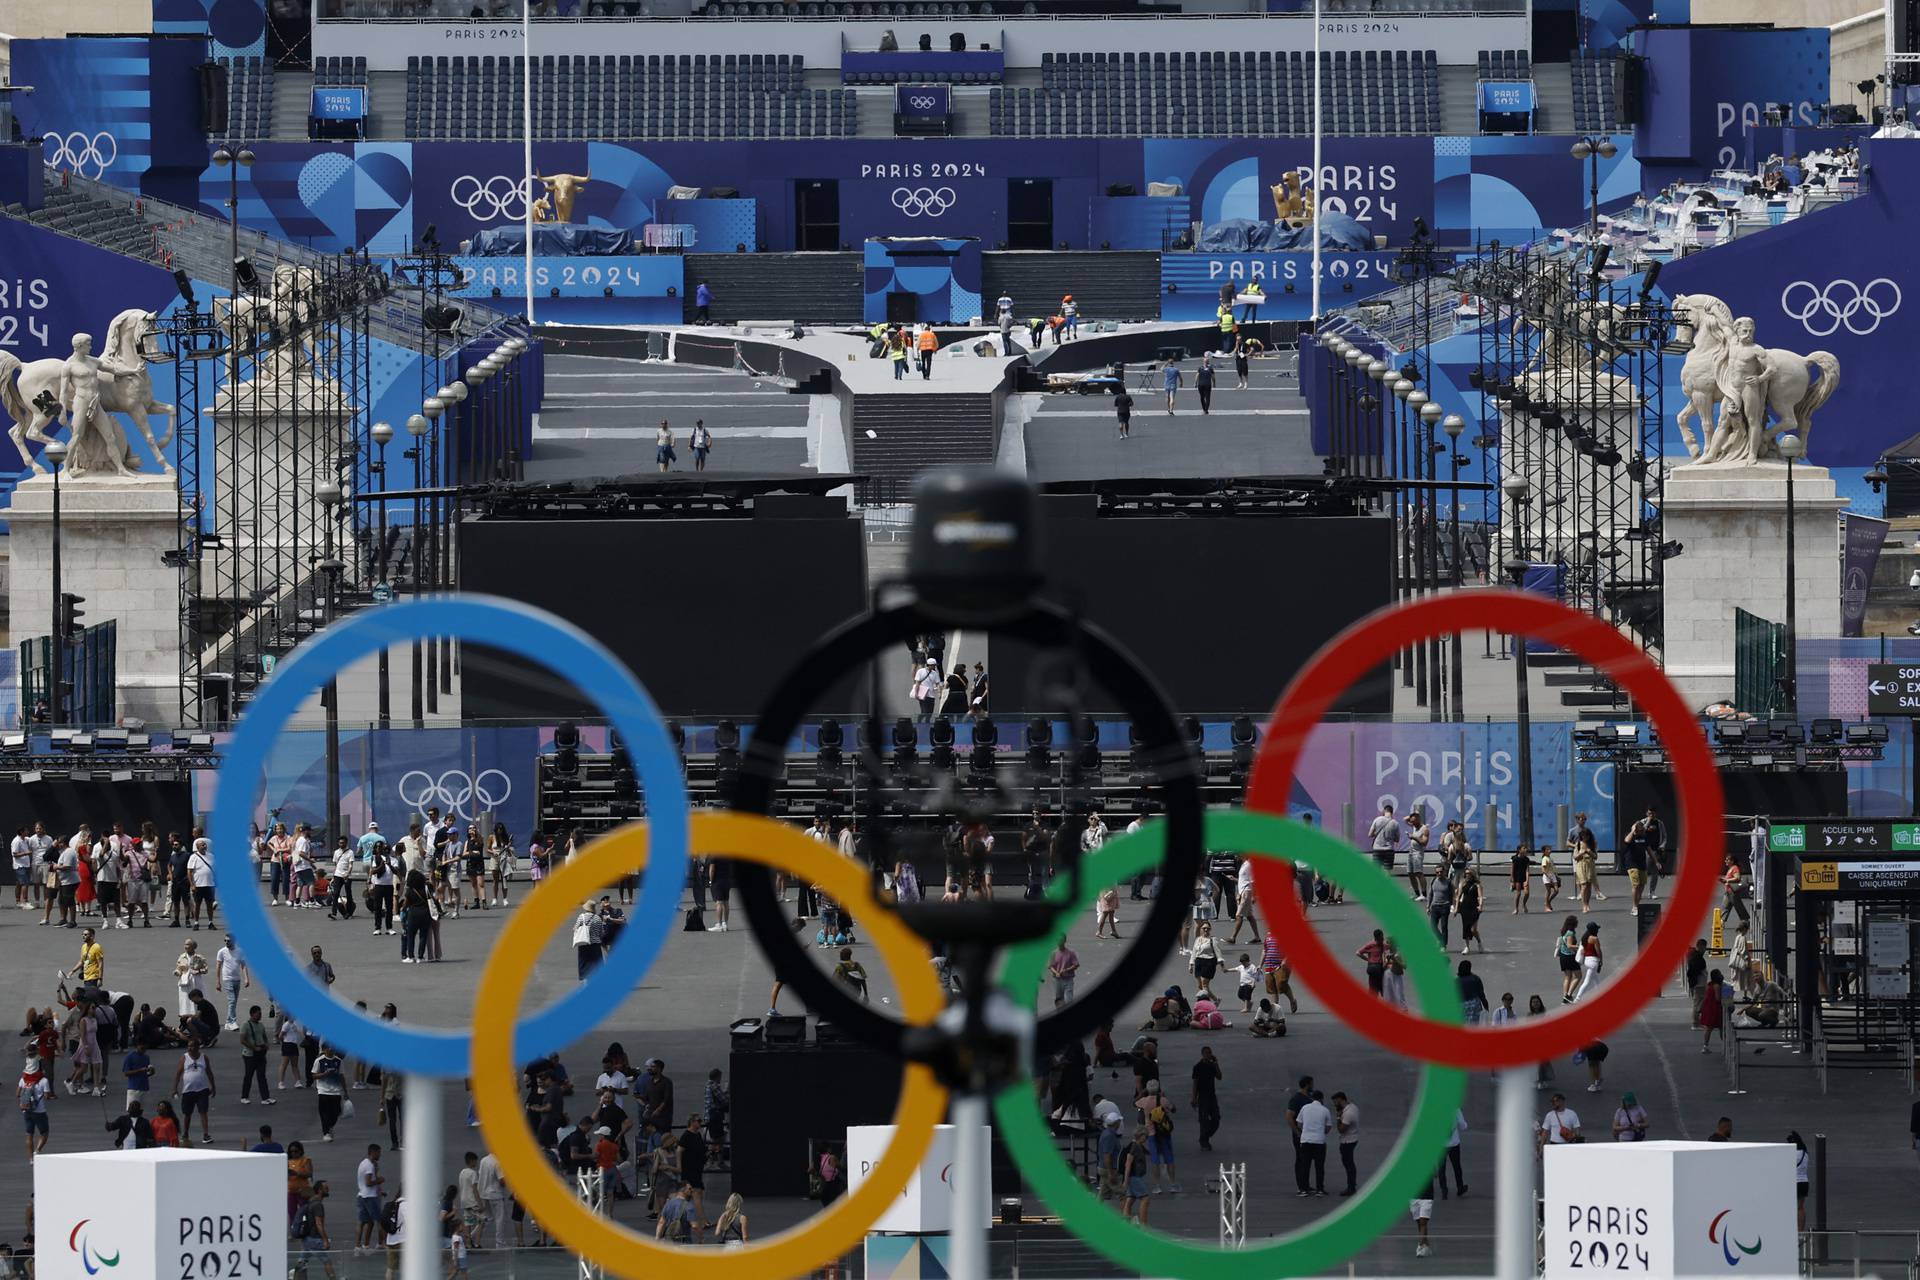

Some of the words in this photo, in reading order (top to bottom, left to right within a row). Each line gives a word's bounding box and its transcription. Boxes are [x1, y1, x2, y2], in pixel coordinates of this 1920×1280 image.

[1363, 23, 1399, 33] 2024
[931, 163, 985, 177] 2024
[562, 267, 641, 286] 2024
[1822, 826, 1854, 834] ACCUEIL
[1857, 826, 1874, 834] PMR
[1847, 872, 1874, 880] CAISSE
[1876, 871, 1919, 879] ASCENSEUR
[1859, 880, 1908, 889] UNIQUEMENT
[1569, 1240, 1649, 1272] 2024
[180, 1248, 262, 1280] 2024
